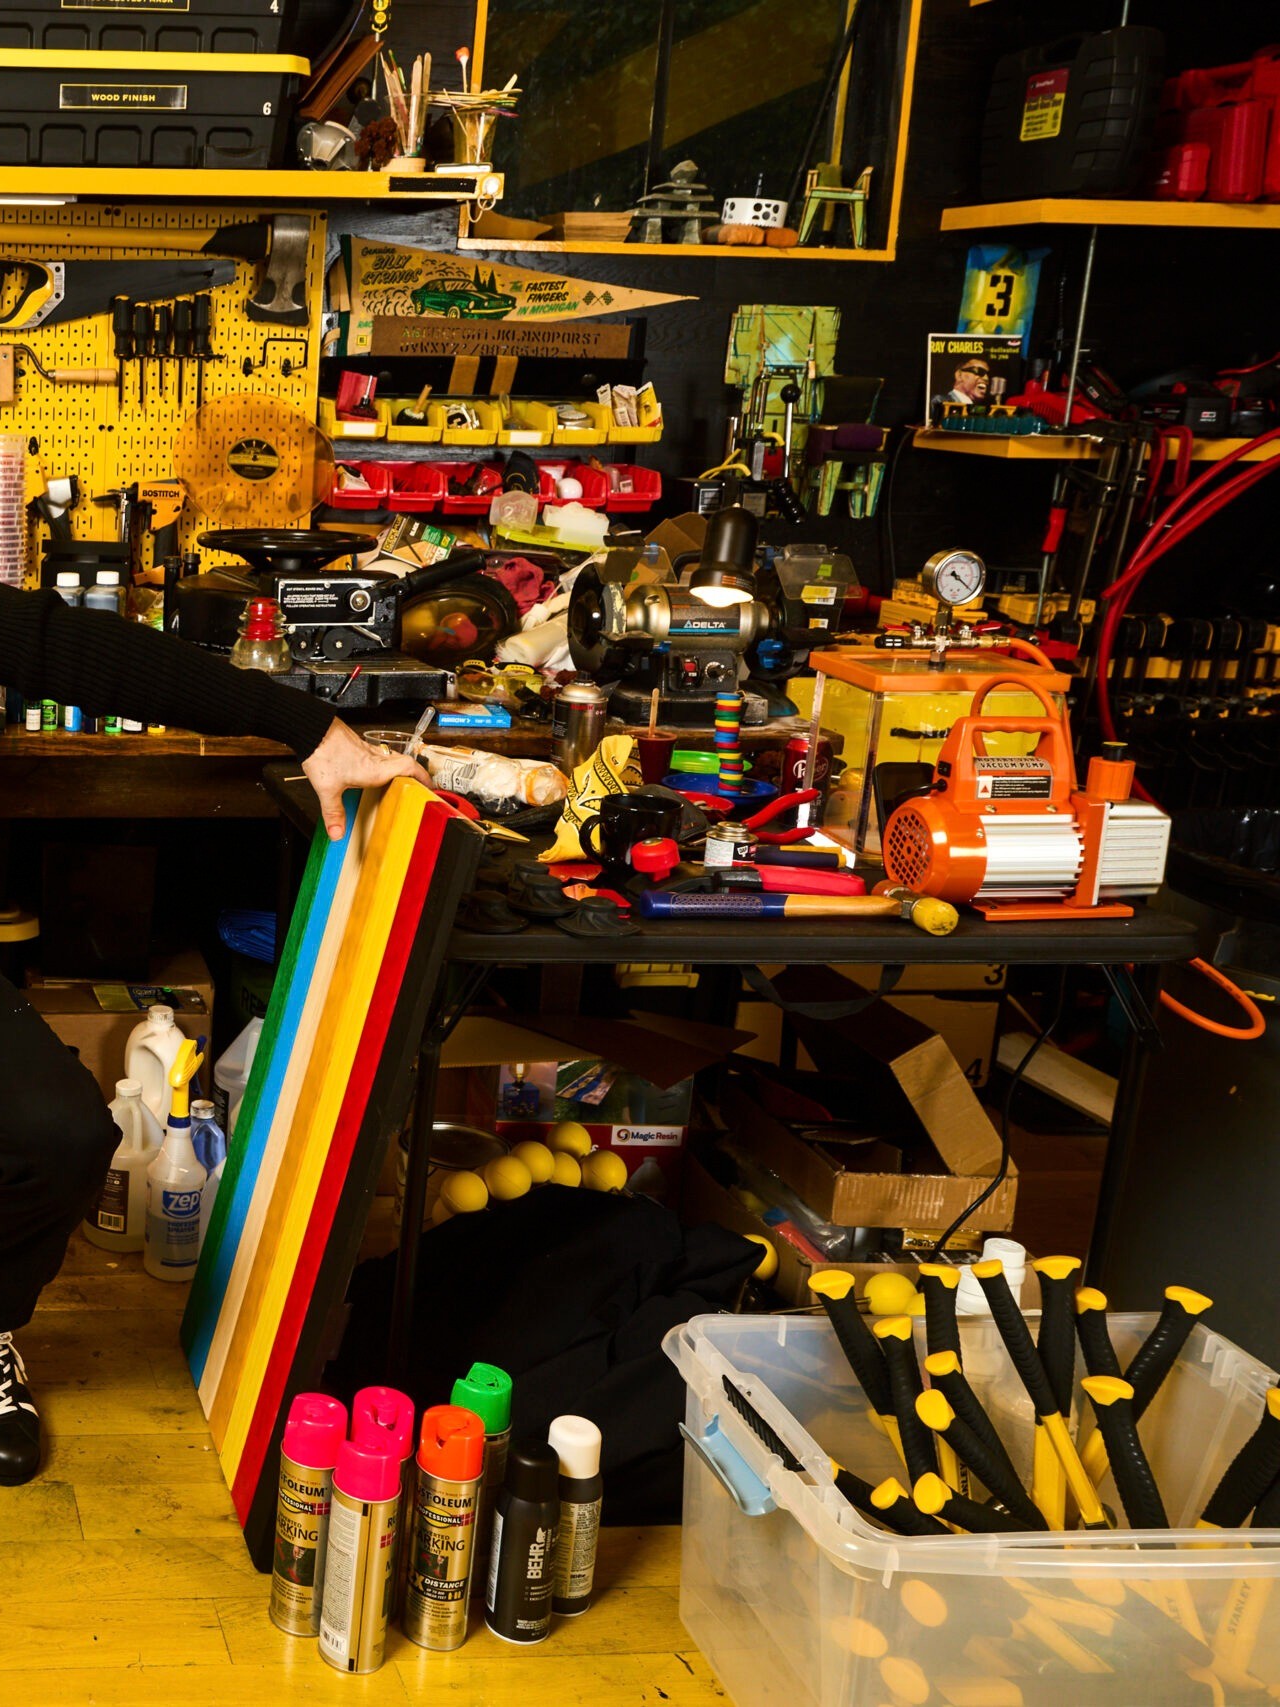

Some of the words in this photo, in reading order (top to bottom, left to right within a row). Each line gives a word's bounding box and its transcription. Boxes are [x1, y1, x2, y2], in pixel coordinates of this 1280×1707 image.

[269, 0, 280, 14] 4
[91, 94, 120, 102] WOOD
[122, 94, 156, 102] FINISH
[262, 102, 272, 116] 6
[372, 255, 412, 270] BILLY
[361, 270, 422, 286] STRINGS
[525, 280, 568, 292] FASTEST
[527, 292, 569, 304] FINGERS
[986, 275, 1015, 317] 3
[516, 305, 528, 315] IN
[528, 302, 580, 314] MICHIGAN
[930, 340, 946, 354] RAY
[947, 341, 984, 354] CHARLES
[142, 490, 180, 498] BOSTITCH
[984, 964, 1006, 986] 3
[965, 1058, 984, 1086] 4
[631, 1132, 656, 1142] Magic
[656, 1132, 678, 1140] Resin
[526, 1543, 546, 1580] BEHR
[424, 1578, 464, 1590] DISTANCE
[1228, 1579, 1252, 1636] STANLEY
